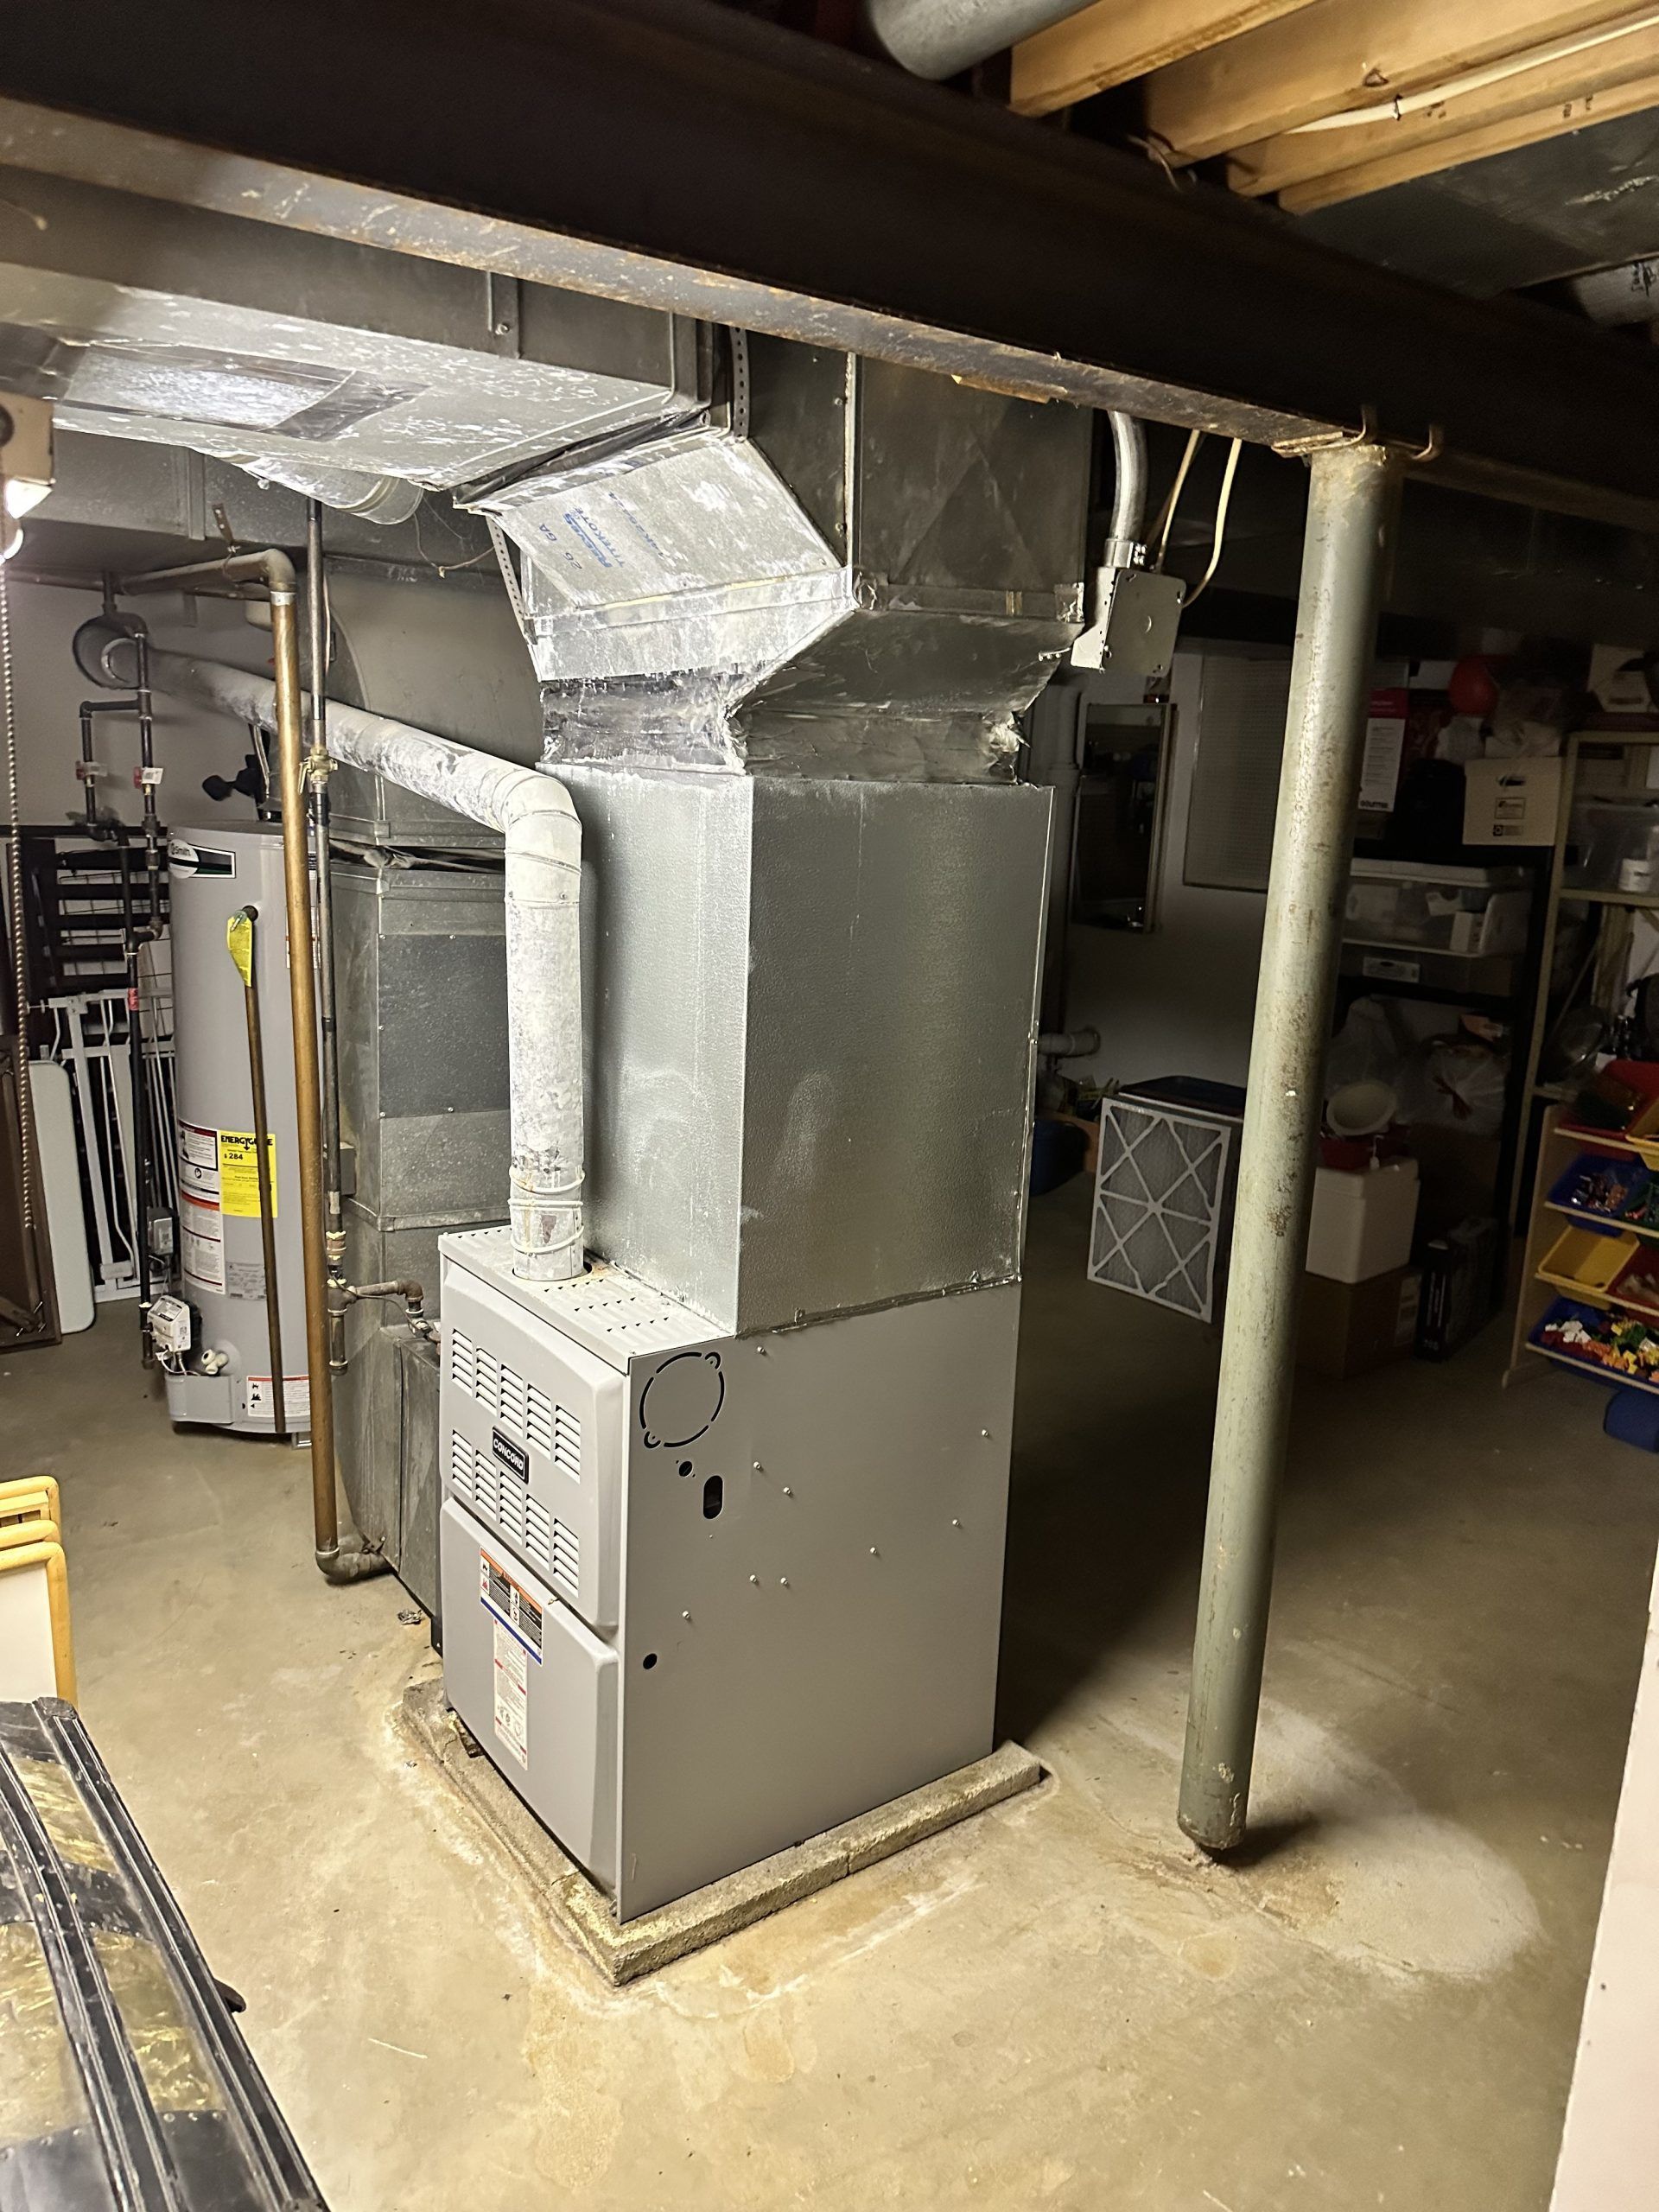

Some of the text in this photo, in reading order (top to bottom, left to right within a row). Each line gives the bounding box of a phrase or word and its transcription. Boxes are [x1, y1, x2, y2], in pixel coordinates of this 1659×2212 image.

[539, 523, 582, 569] 26 GA
[493, 1439, 524, 1470] CONCORD
